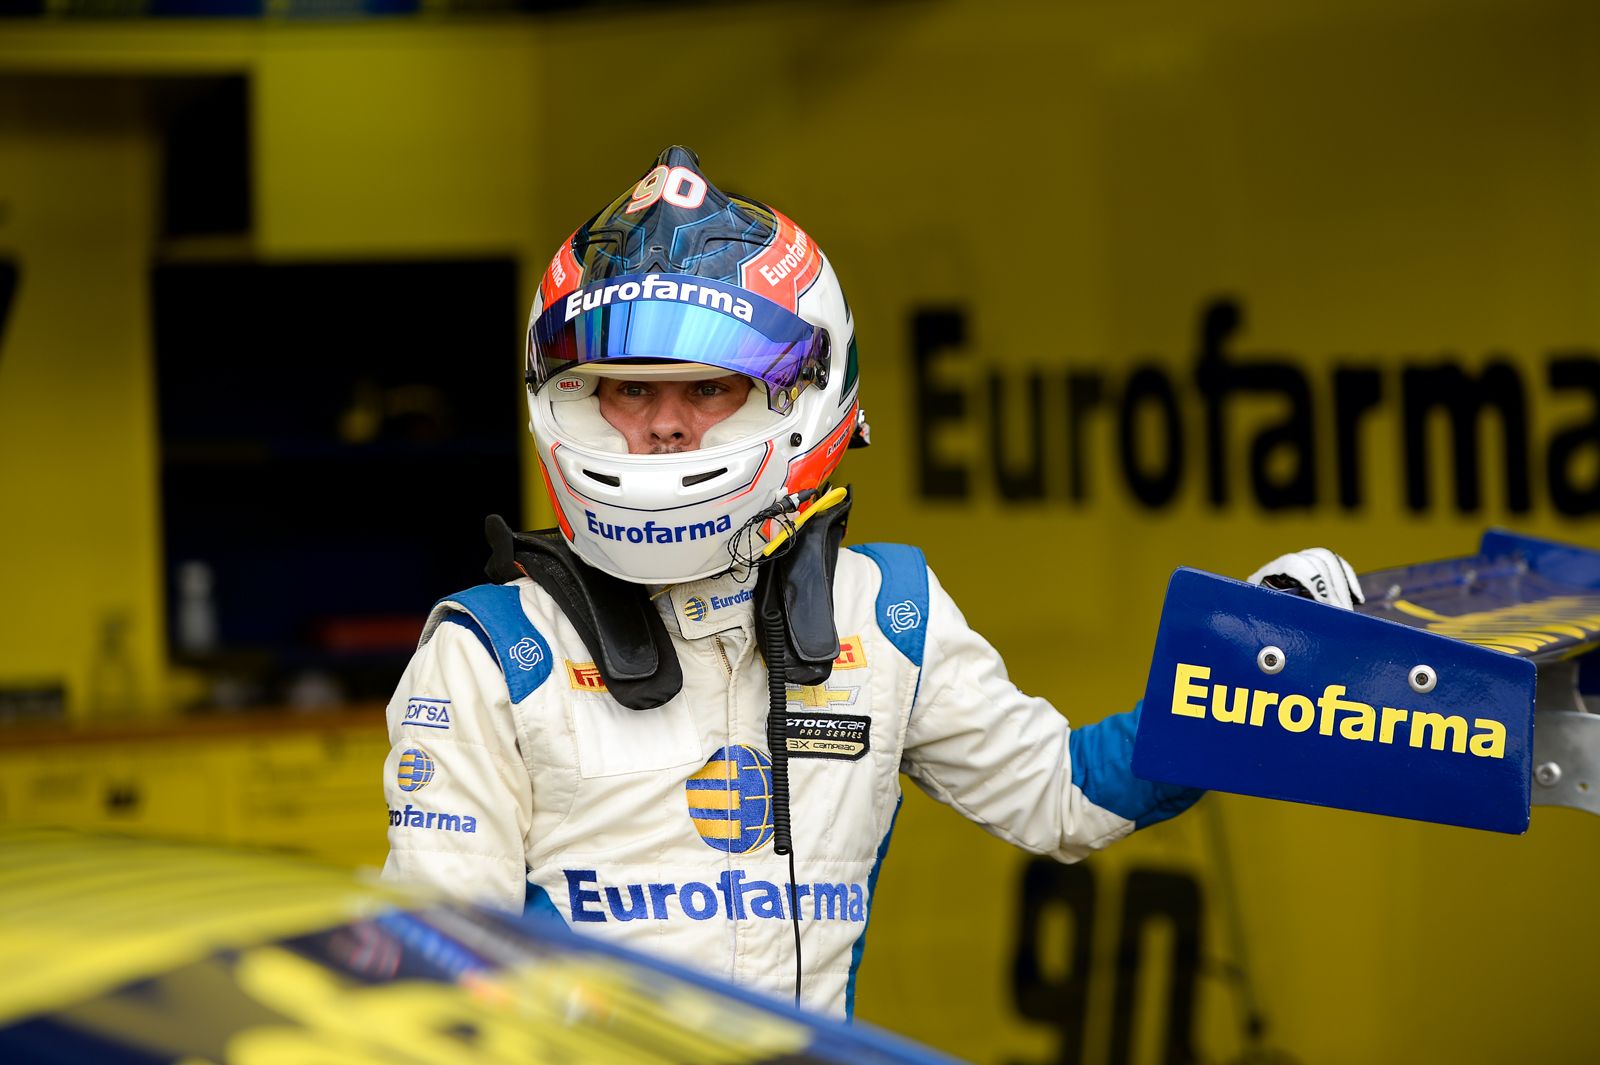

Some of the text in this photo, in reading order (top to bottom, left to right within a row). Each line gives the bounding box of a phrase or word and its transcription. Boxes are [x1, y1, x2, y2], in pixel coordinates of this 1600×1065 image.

[626, 165, 707, 214] 90
[564, 274, 754, 322] Eurofarma
[908, 298, 1600, 518] Eurofarma
[585, 509, 732, 544] Eurofarma
[799, 728, 863, 739] PRO SERIES
[1171, 663, 1507, 759] Eurofarma
[789, 739, 810, 750] 3X
[563, 868, 865, 923] Eurofarma
